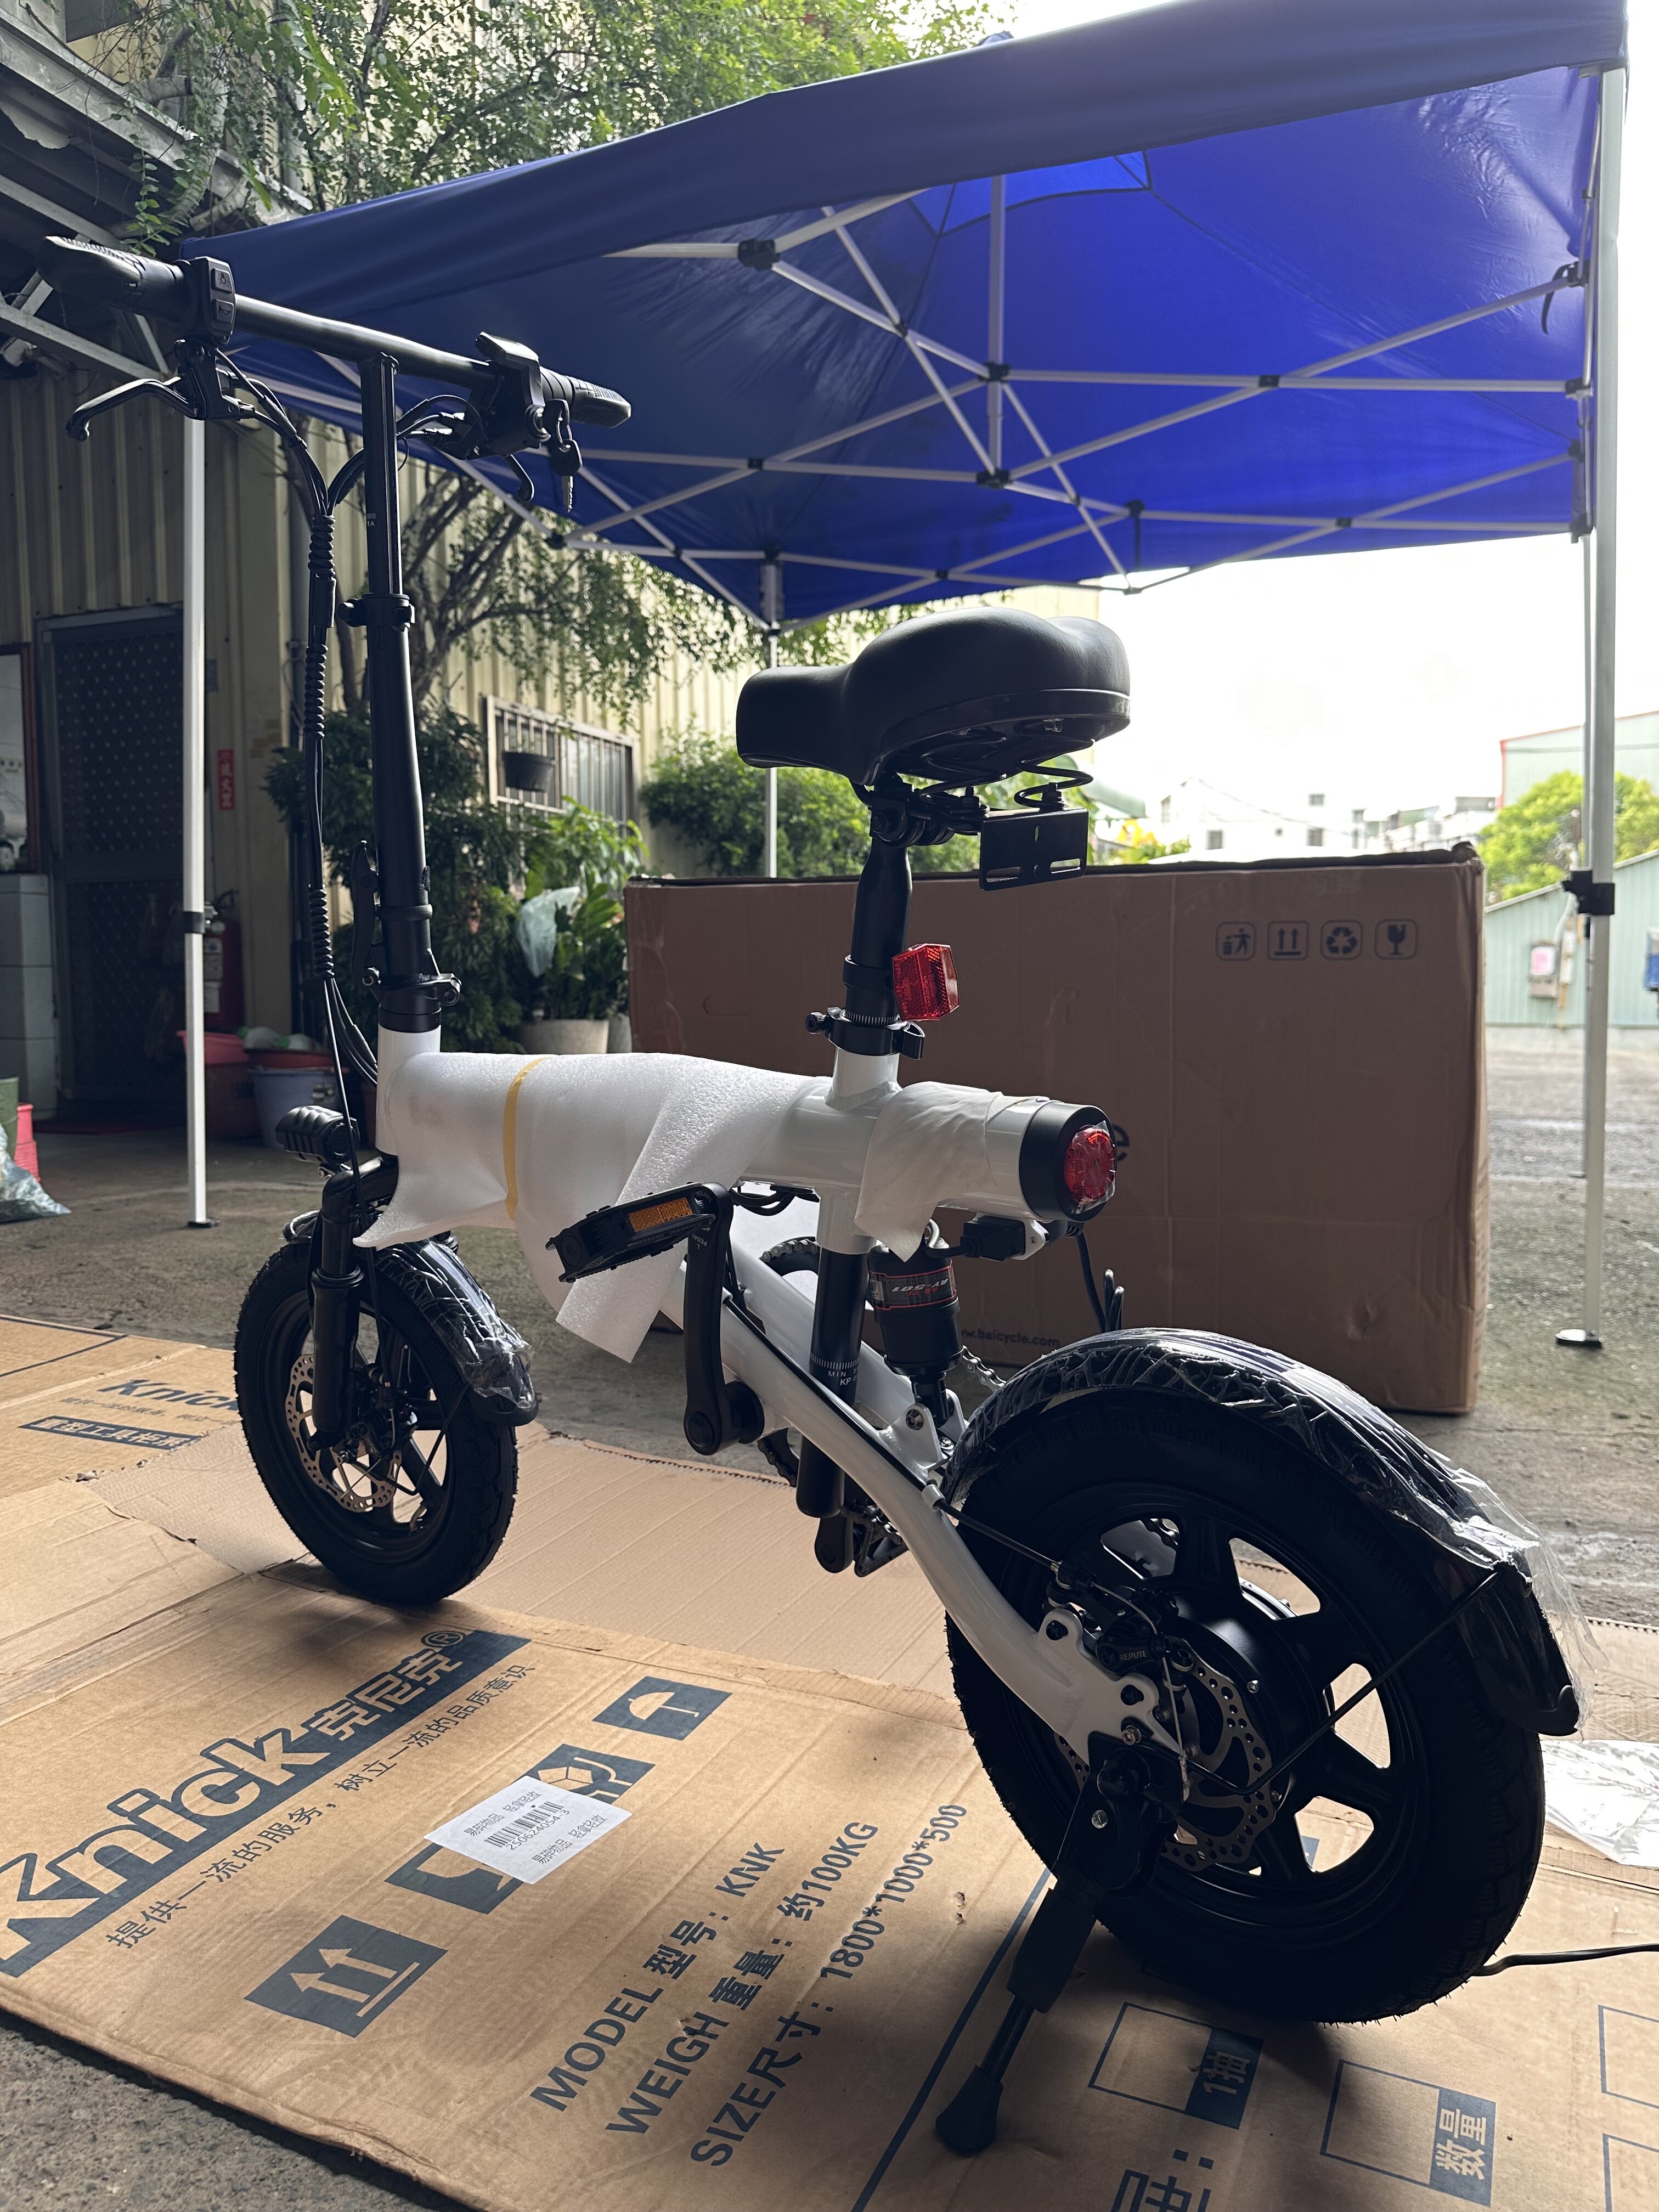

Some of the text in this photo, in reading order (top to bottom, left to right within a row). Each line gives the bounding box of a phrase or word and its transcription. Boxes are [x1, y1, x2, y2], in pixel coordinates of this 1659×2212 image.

[891, 1278, 948, 1292] AY-501
[840, 1377, 851, 1386] KP
[1120, 1650, 1148, 1661] REPUTE
[0, 1729, 331, 1961] Knick
[505, 1809, 570, 1851] 250624054-3
[530, 1983, 664, 2112] MODEL
[714, 1842, 786, 1898] KNK
[605, 2011, 729, 2135] WEIGH
[1435, 2108, 1486, 2180] 数量
